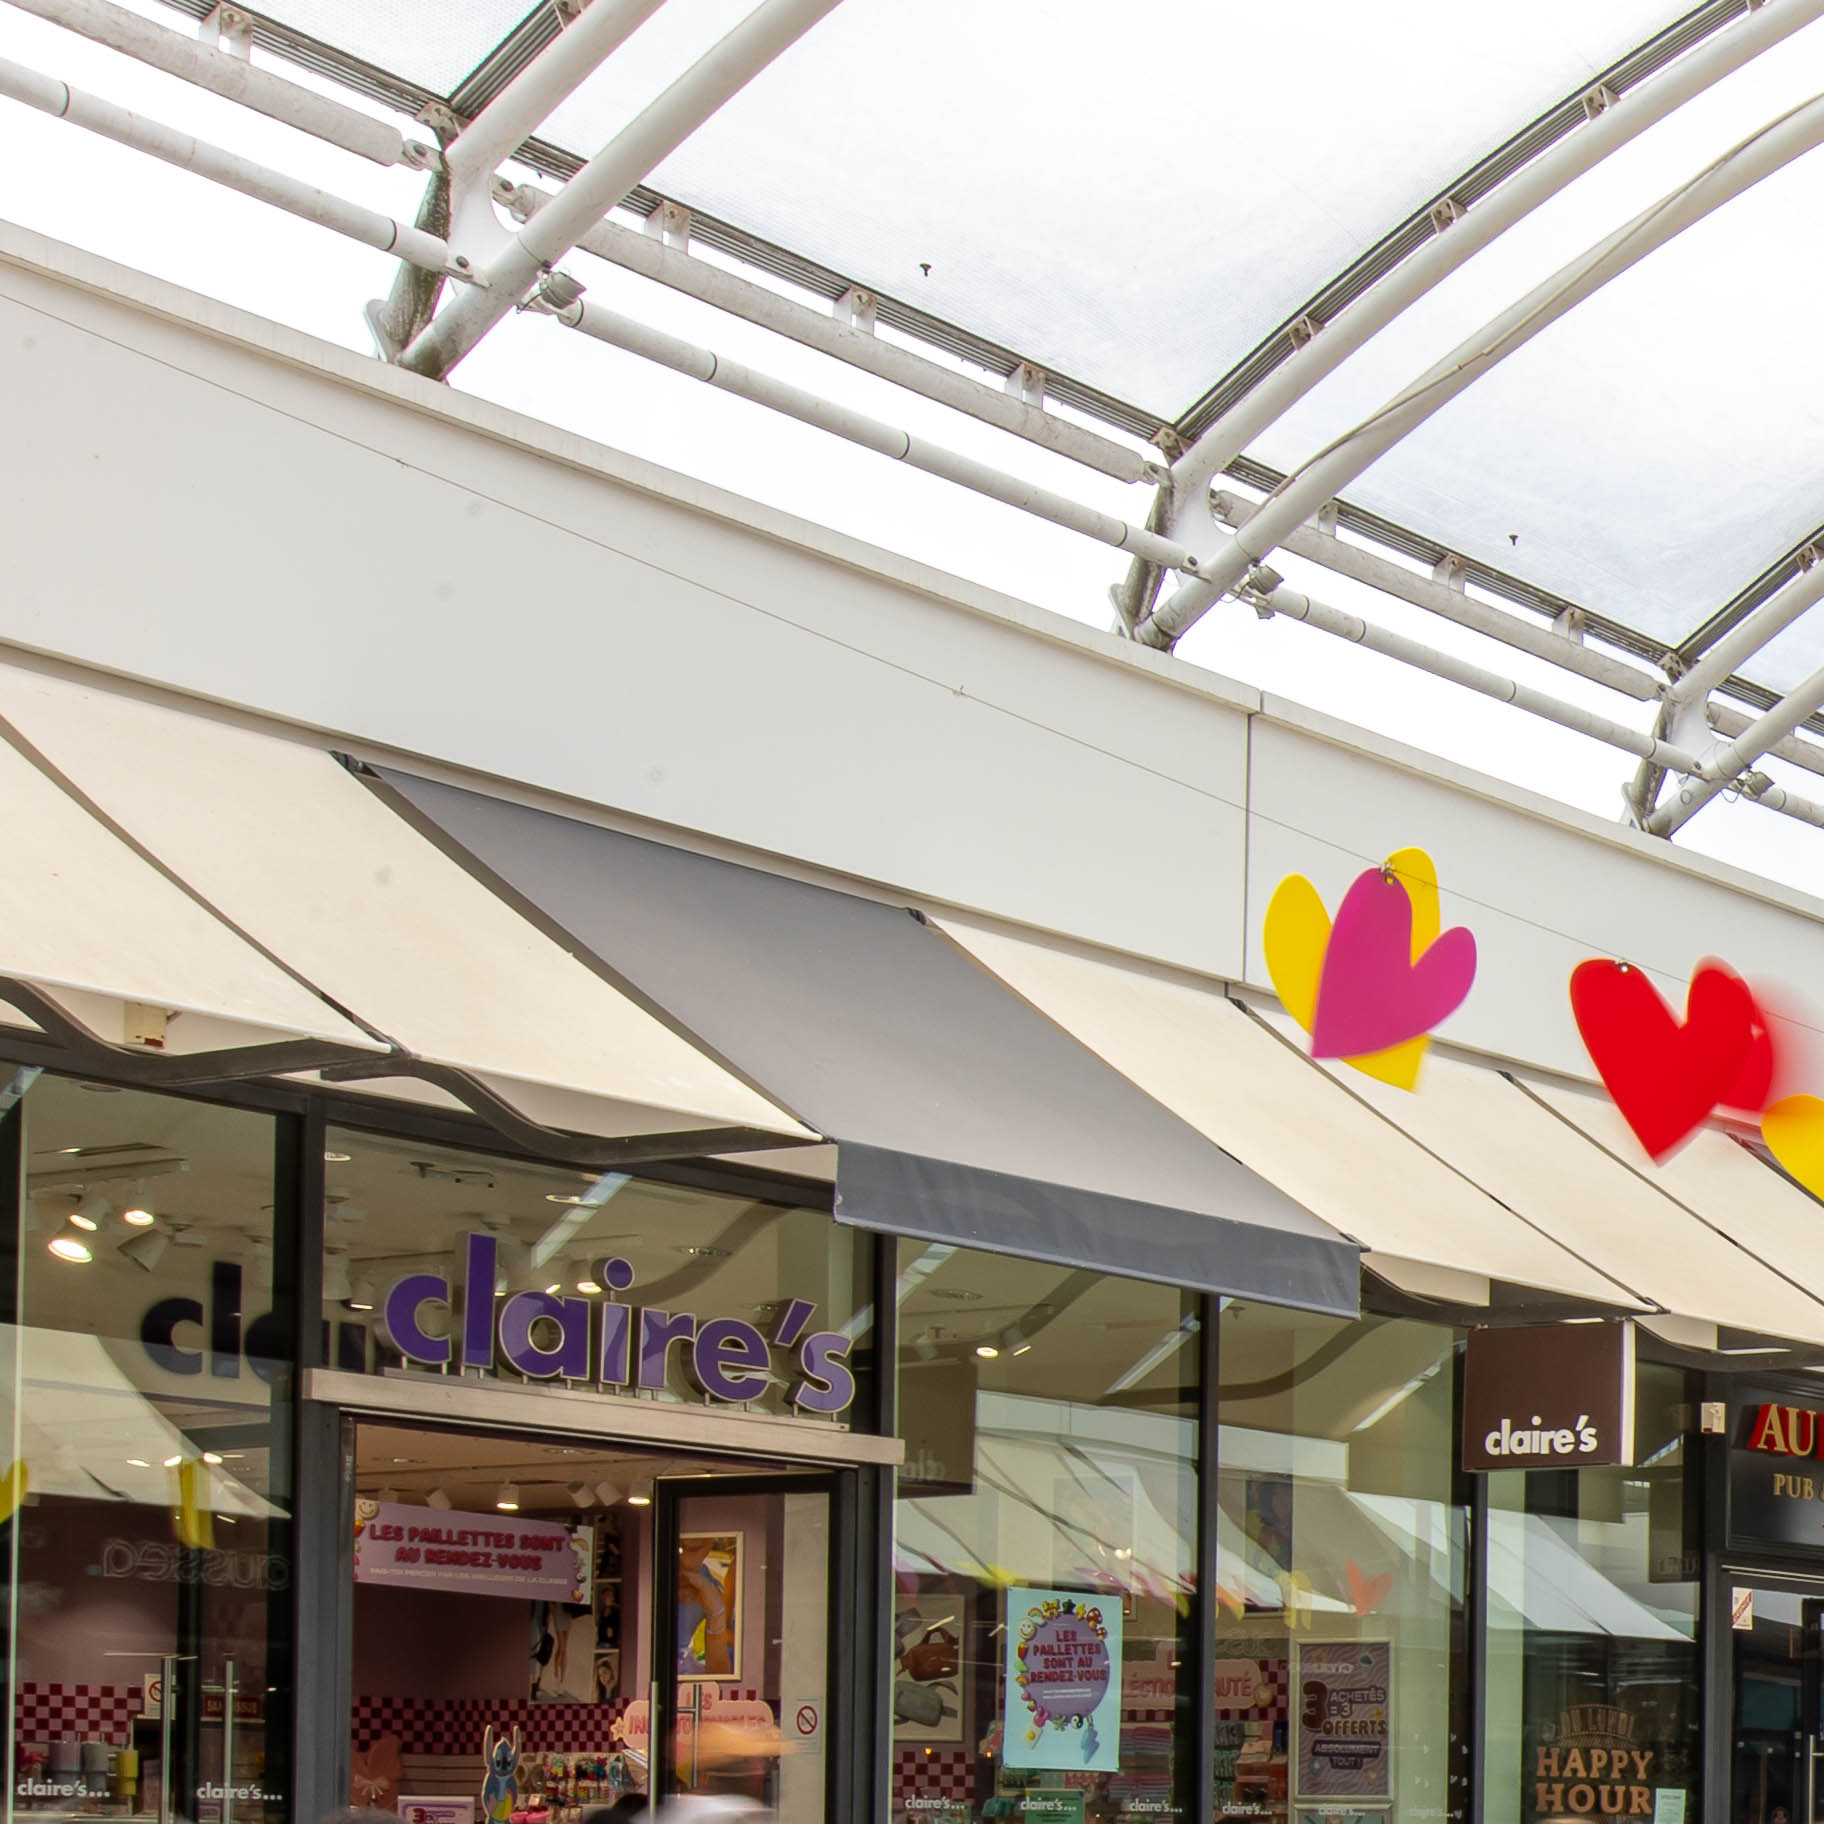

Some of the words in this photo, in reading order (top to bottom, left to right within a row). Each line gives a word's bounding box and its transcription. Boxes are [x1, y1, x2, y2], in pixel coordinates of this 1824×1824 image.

[385, 1233, 857, 1412] claire's
[1485, 1415, 1598, 1456] claire's
[1756, 1402, 1817, 1457] AU
[1773, 1473, 1815, 1500] PUB
[370, 1523, 403, 1542] LES
[408, 1526, 515, 1549] PAILLETTES
[520, 1534, 566, 1552] SONT
[395, 1547, 421, 1563] AU
[1032, 1643, 1102, 1656] PAILLETTES
[1056, 1630, 1077, 1642] LES
[1302, 1681, 1327, 1730] 3
[1322, 1720, 1387, 1735] OFFERTS
[1536, 1746, 1655, 1780] HAPPY
[1536, 1783, 1653, 1815] HOUR
